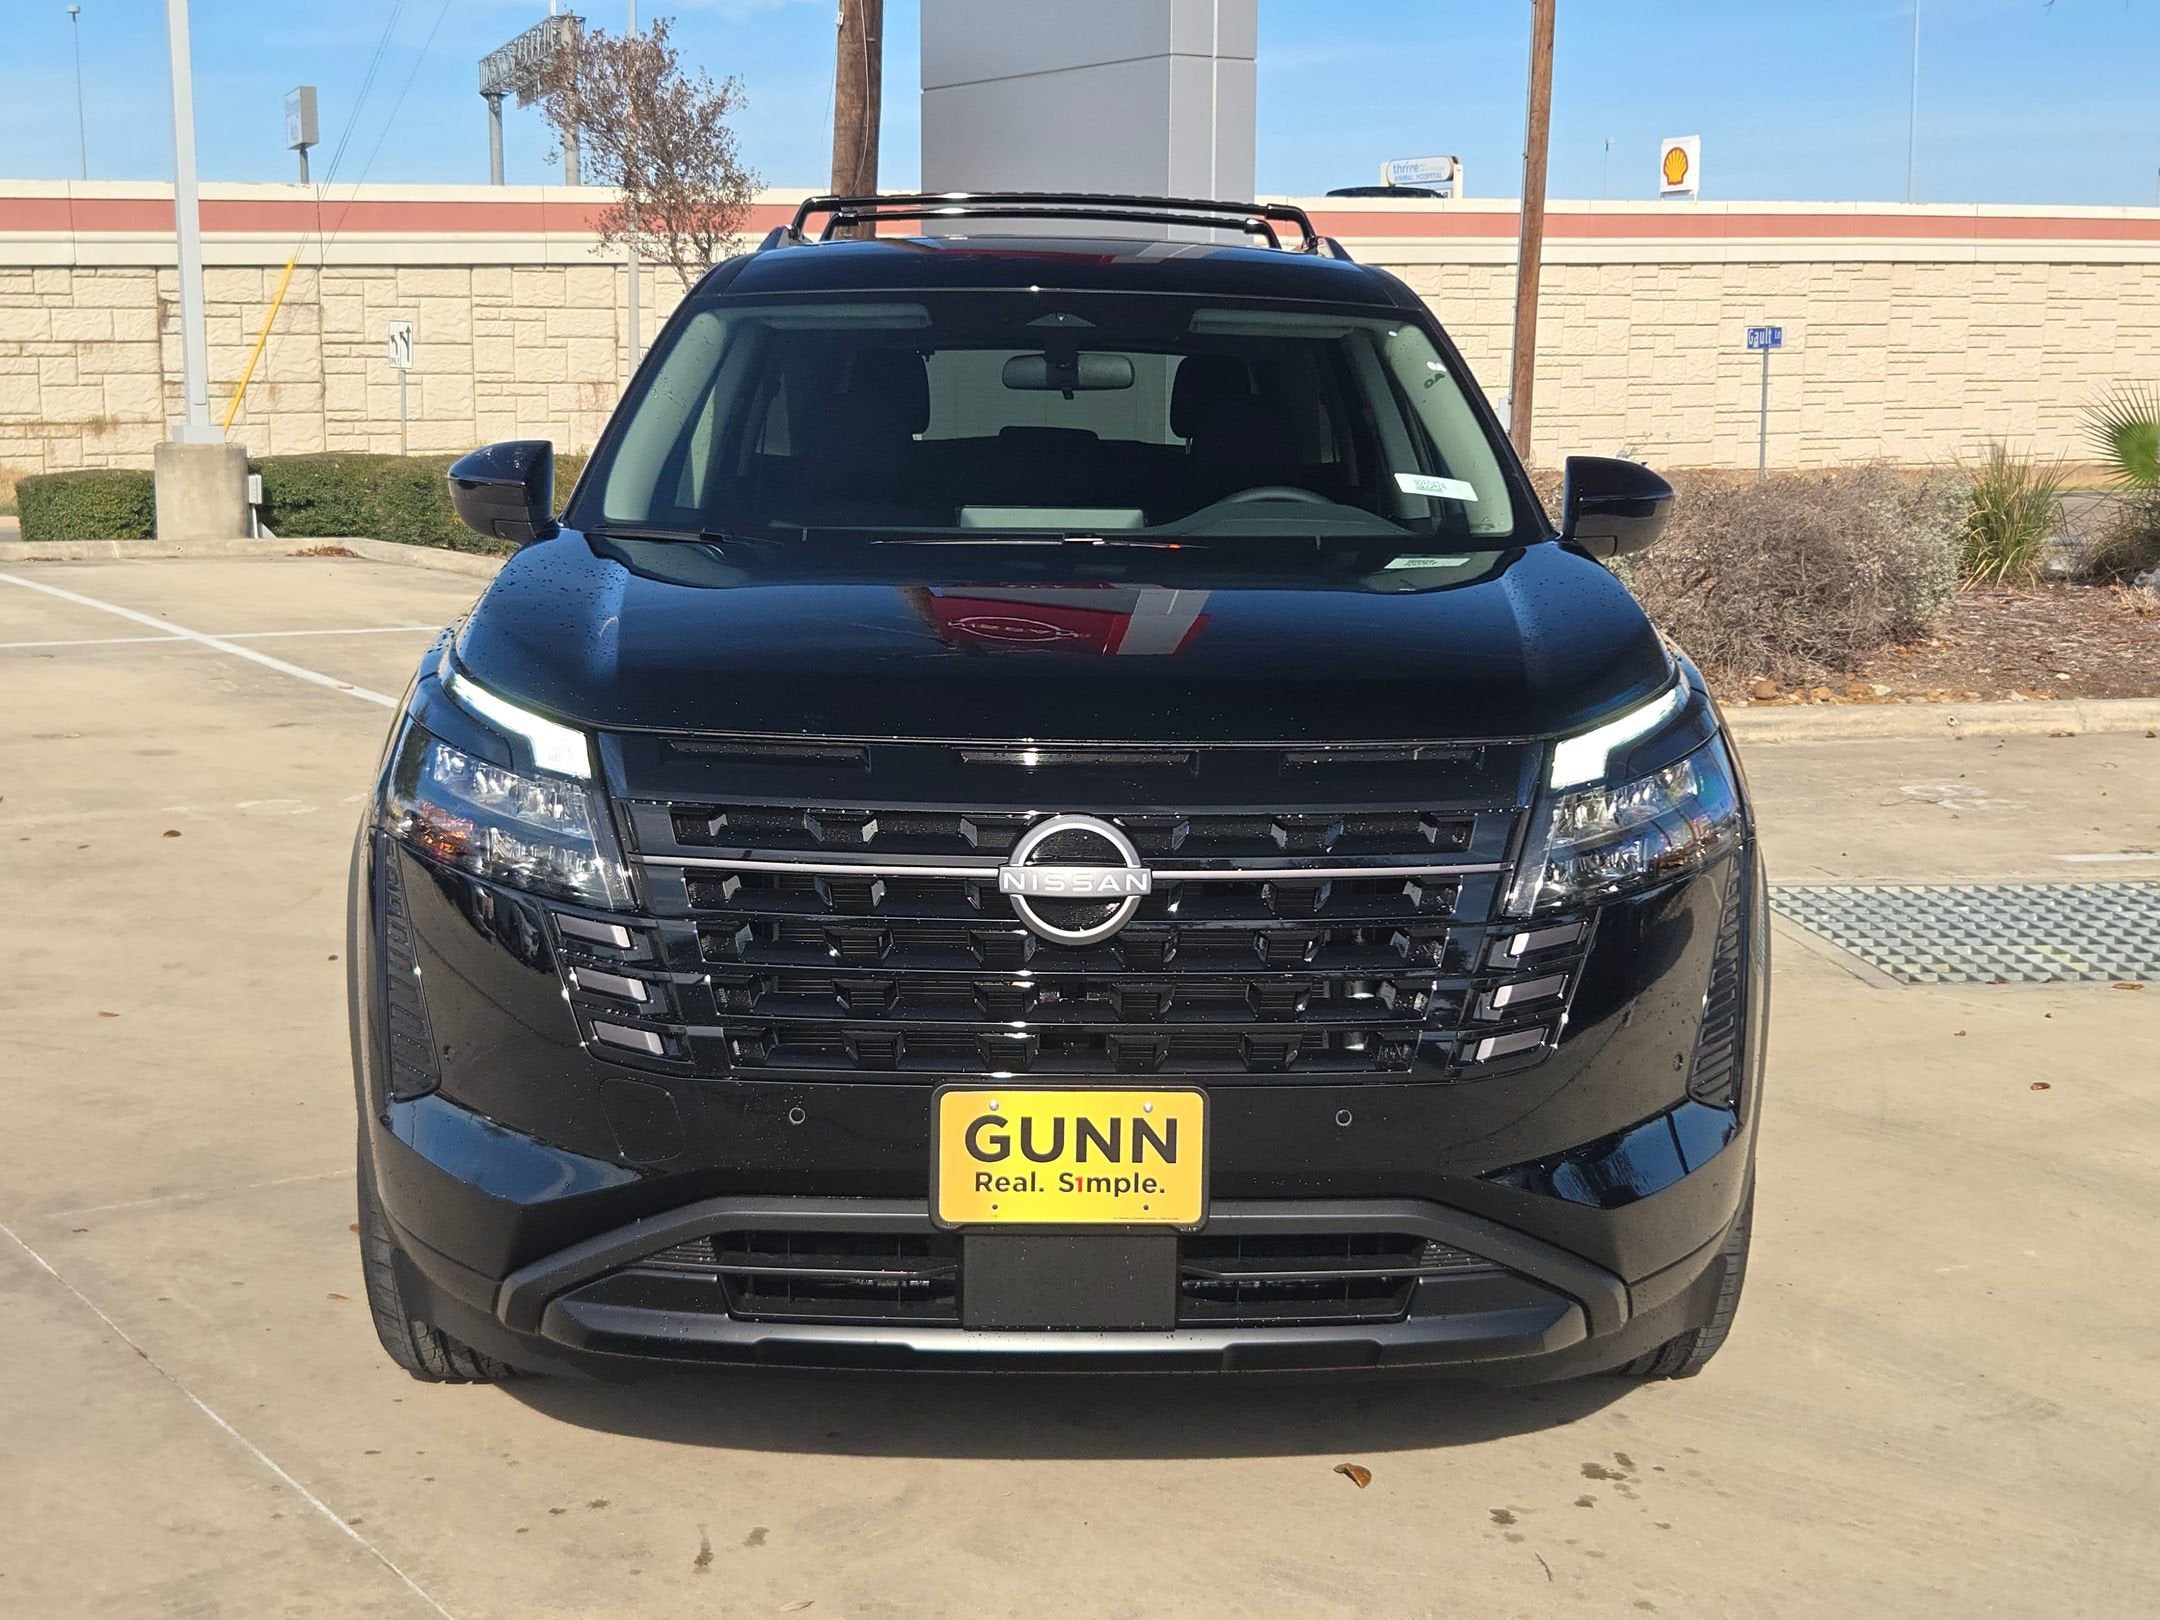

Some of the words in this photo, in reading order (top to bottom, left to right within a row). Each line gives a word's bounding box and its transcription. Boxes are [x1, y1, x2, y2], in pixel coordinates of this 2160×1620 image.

[1393, 162, 1419, 174] thrive
[1748, 327, 1771, 348] Gault
[1003, 871, 1147, 892] NISSAN
[964, 1114, 1178, 1164] GUNN
[975, 1171, 1044, 1193] Real.
